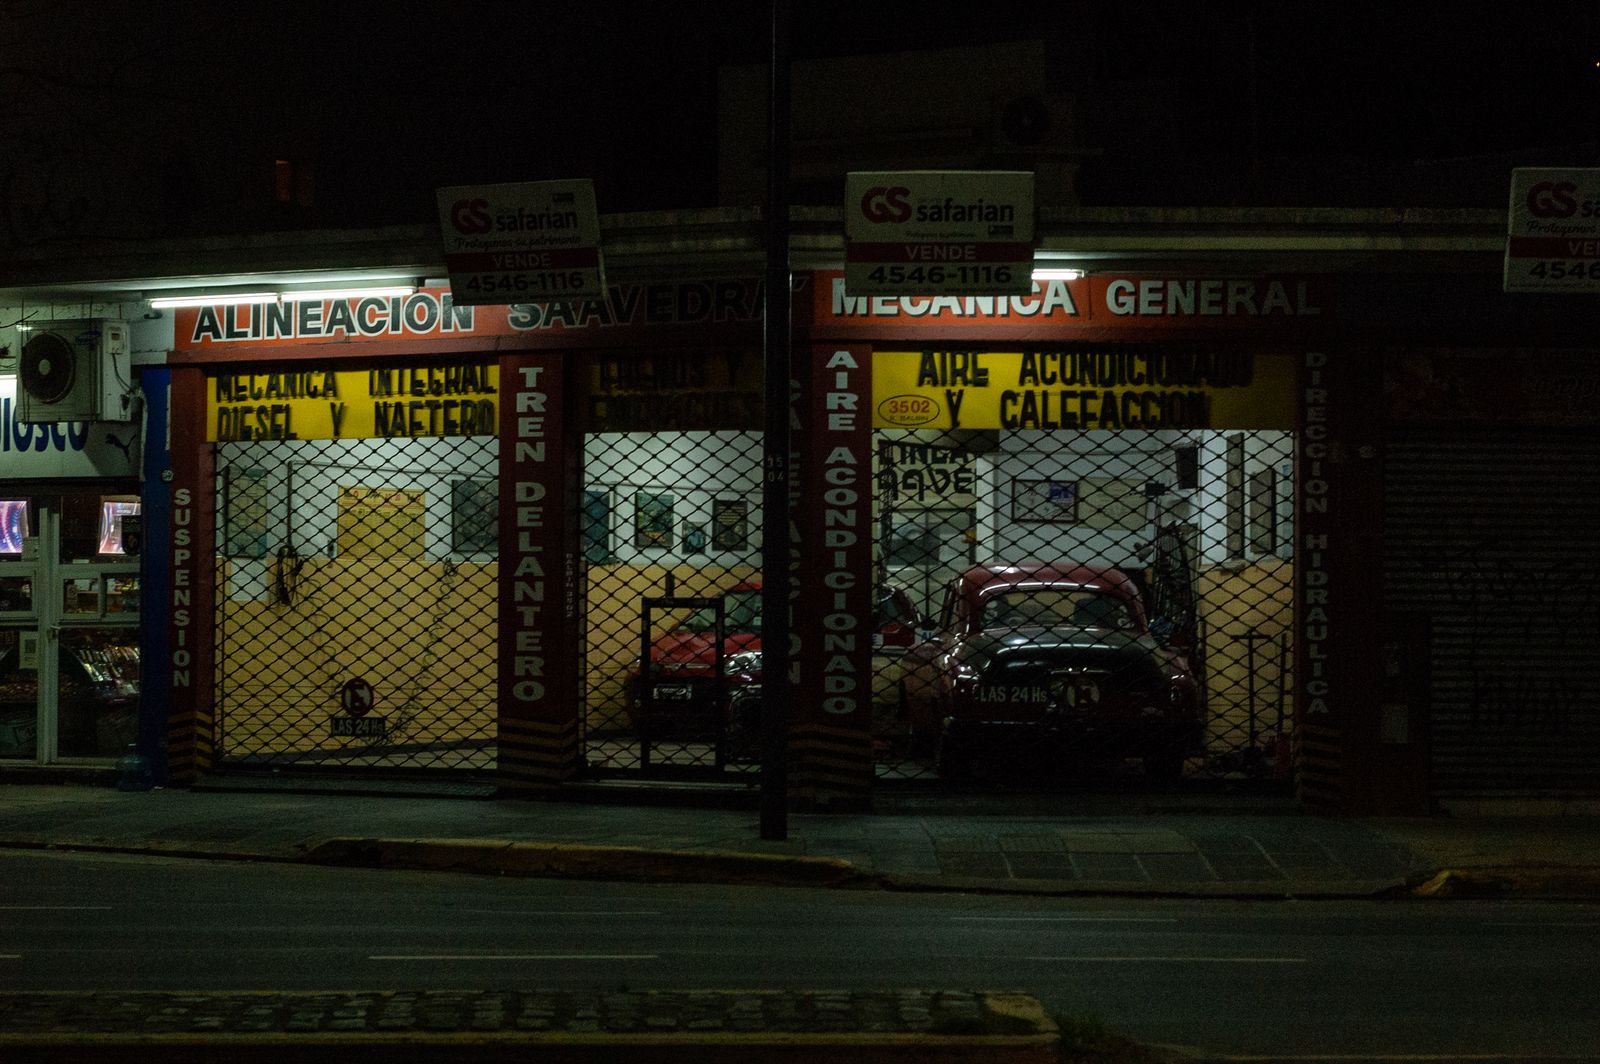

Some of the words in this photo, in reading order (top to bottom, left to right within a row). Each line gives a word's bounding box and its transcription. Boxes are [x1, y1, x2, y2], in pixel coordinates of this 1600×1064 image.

[496, 206, 577, 232] safarian
[916, 198, 1014, 222] safarian
[492, 253, 551, 269] VENDE
[906, 245, 977, 260] VENDE
[466, 272, 584, 292] 4546-1116
[868, 266, 1012, 284] 4546-1116
[1105, 279, 1321, 317] GENERAL
[191, 293, 475, 343] ALINEACION
[918, 350, 989, 387] AIRE
[824, 350, 859, 432] AIRE
[889, 400, 930, 414] 3502
[946, 389, 963, 429] Y
[1000, 389, 1210, 430] CALEFACCION
[217, 404, 297, 441] DIESEL
[330, 402, 344, 436] Y
[515, 366, 547, 463] TREN
[1304, 351, 1329, 513] DIRECCION
[173, 488, 192, 688] SUSPENSION
[512, 481, 547, 701] DELANTERO
[822, 446, 859, 714] ACONDICIONADO
[1305, 533, 1329, 715] HIDRAULICA
[979, 686, 1007, 703] LAS
[1010, 686, 1029, 703] 24
[332, 719, 353, 736] LAS
[355, 719, 369, 735] 24
